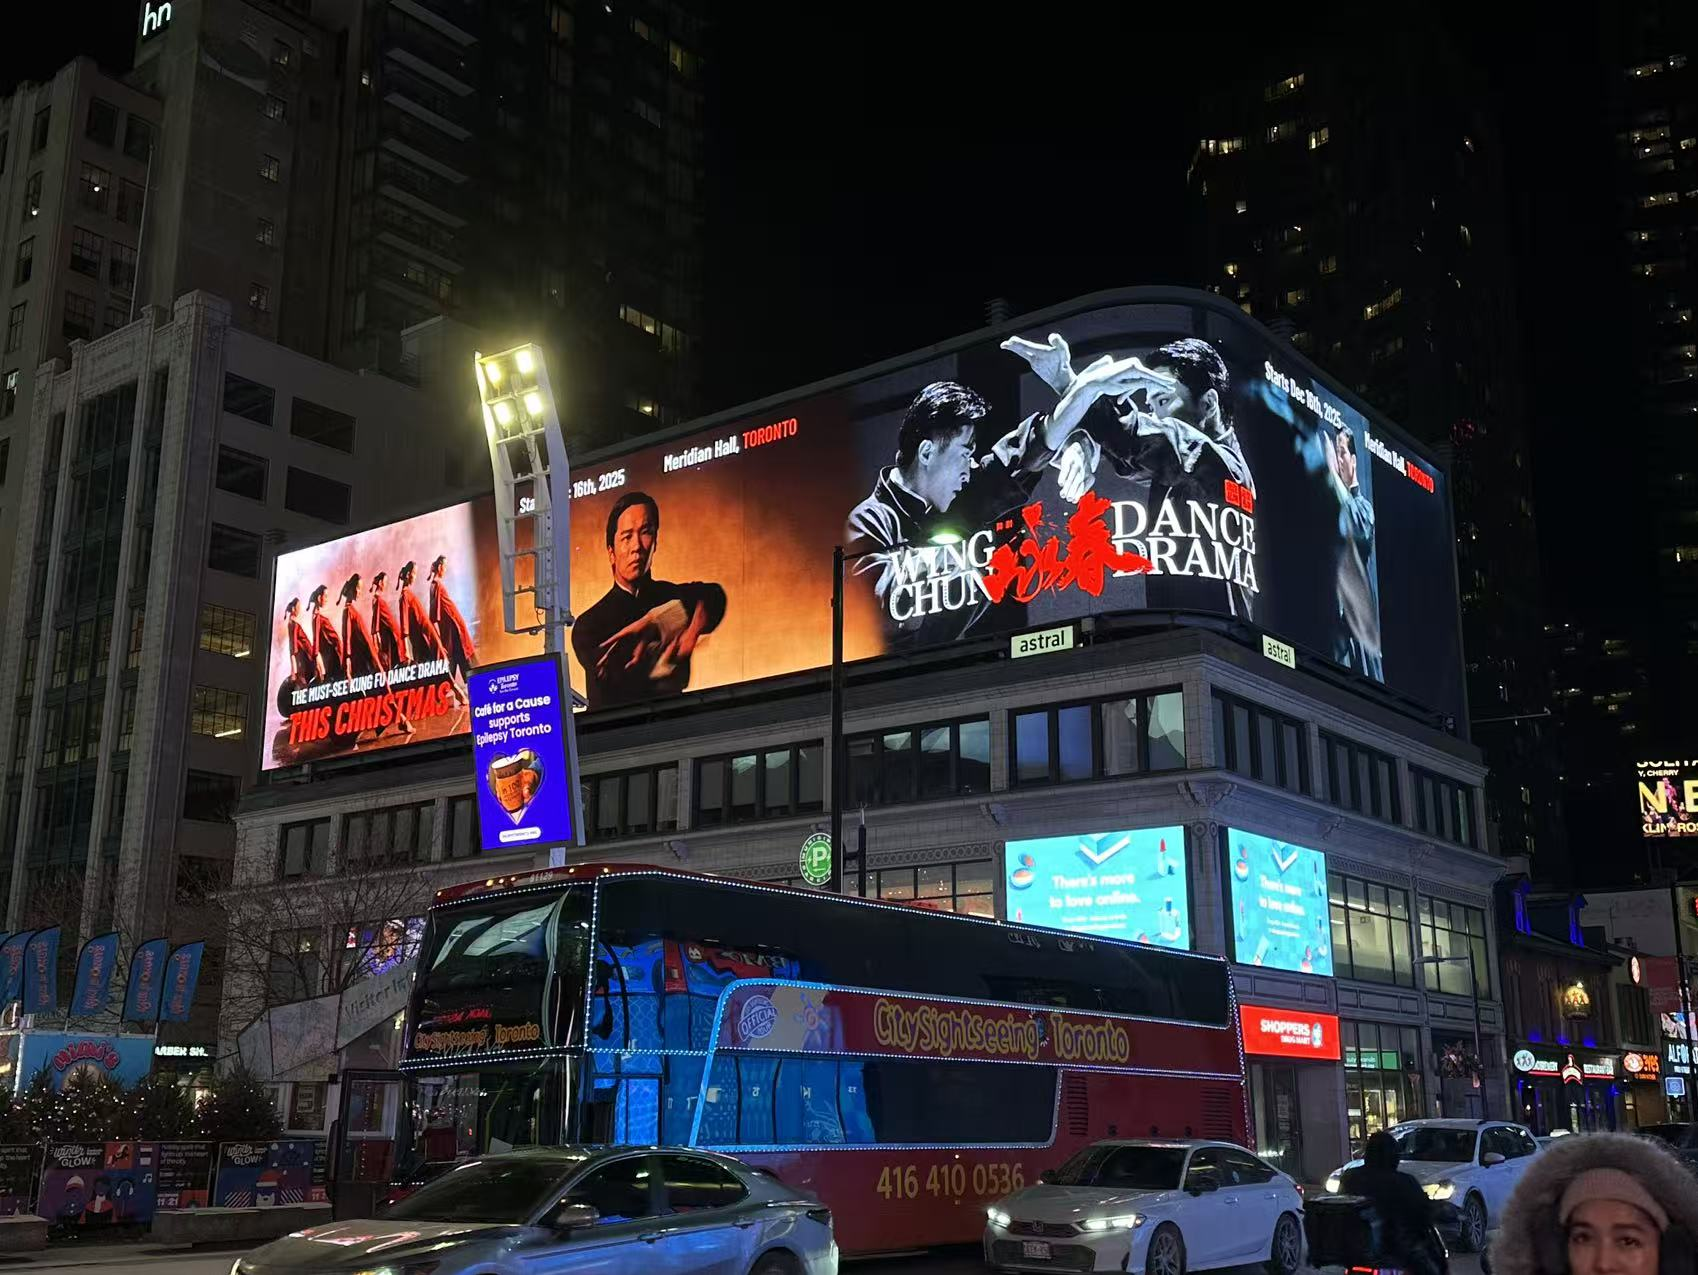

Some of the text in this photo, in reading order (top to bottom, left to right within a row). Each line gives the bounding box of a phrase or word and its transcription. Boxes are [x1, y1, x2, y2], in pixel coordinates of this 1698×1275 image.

[143, 2, 171, 36] hn
[1264, 360, 1342, 429] Starts Dec 16th, 2025
[663, 418, 798, 473] Meridian Hall, TORONTO
[1364, 430, 1392, 466] Meridian
[1406, 461, 1434, 493] TORONTO
[573, 479, 597, 499] 16th,
[599, 469, 625, 492] 2025
[1111, 500, 1255, 556] DANCE
[888, 529, 996, 586] WING
[1111, 537, 1260, 594] DRAMA
[889, 567, 994, 621] CHUN
[1020, 630, 1065, 653] astral
[1267, 641, 1292, 664] astral
[291, 658, 450, 706] THE MUST-SEE KUNG FU DANCE DRAMA
[288, 680, 452, 745] THIS CHRISTMAS
[489, 712, 531, 730] supports
[493, 702, 506, 714] for
[506, 701, 514, 711] a
[514, 696, 551, 710] Cause
[476, 723, 552, 748] Epilepsy Toronto
[1646, 769, 1679, 777] CHERRY
[813, 846, 827, 867] P
[495, 1022, 540, 1043] Toronto
[1049, 1012, 1130, 1063] Toronto
[1260, 1019, 1311, 1037] SHOPPERS
[61, 1156, 91, 1168] GLOW
[234, 1154, 259, 1166] GLOW
[876, 1161, 1025, 1199] 416 410 0536
